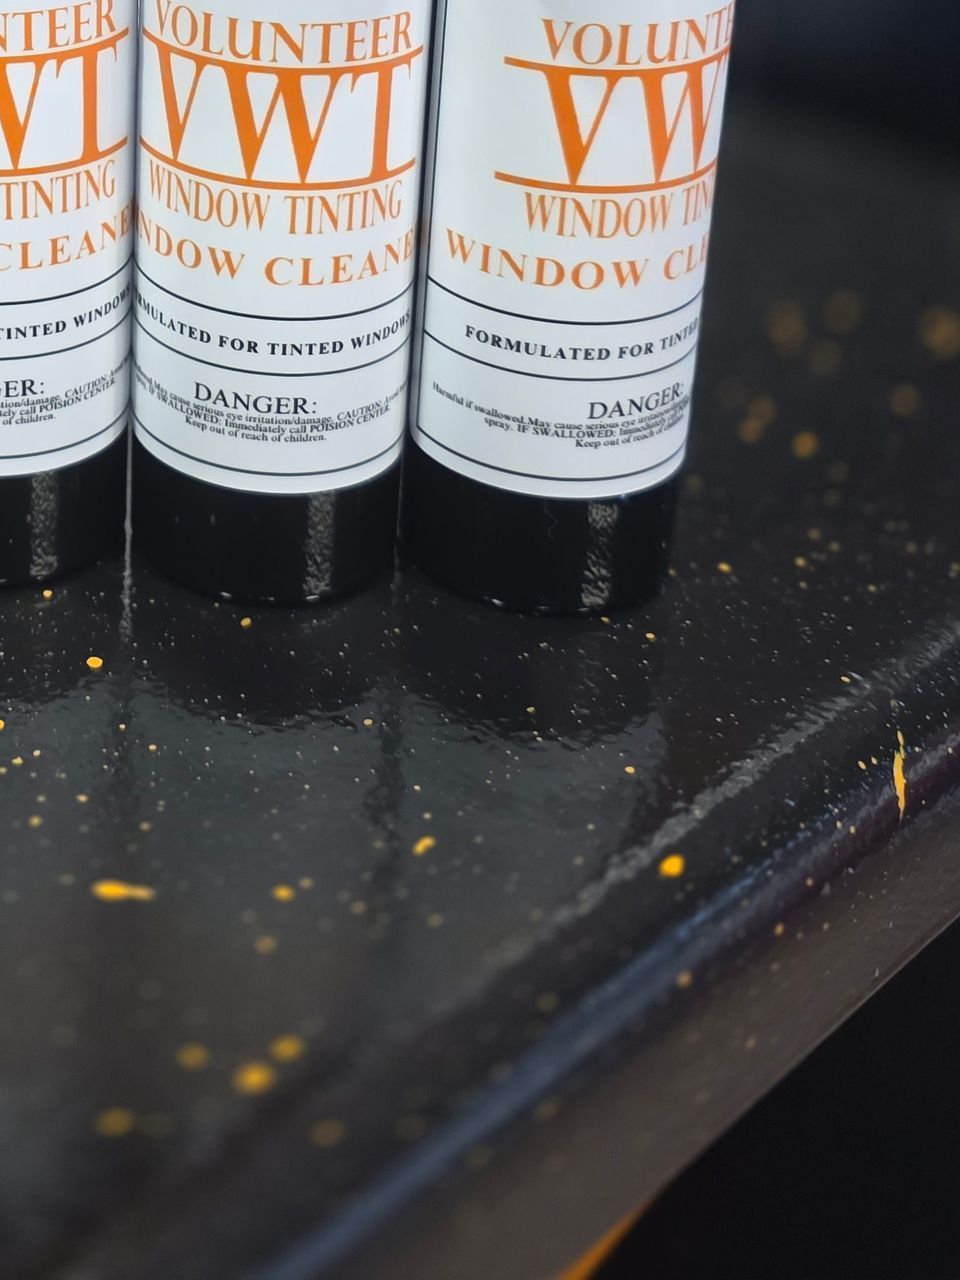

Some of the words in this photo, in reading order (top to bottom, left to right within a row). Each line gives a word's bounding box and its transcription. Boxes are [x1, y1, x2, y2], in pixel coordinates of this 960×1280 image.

[153, 42, 412, 185] VWT
[149, 159, 271, 232] WINDOW
[284, 179, 402, 235] TINTING
[524, 192, 674, 239] WINDOW
[446, 227, 650, 290] WINDOW
[218, 335, 259, 354] FOR
[267, 340, 343, 356] TINTED
[350, 308, 410, 350] WINDOWS
[465, 324, 611, 361] FORMULATED
[617, 342, 654, 359] FOR
[19, 406, 36, 416] call
[193, 403, 225, 417] serious
[226, 412, 243, 421] eye
[336, 399, 382, 421] CAUTION:
[194, 382, 317, 416] DANGER:
[432, 381, 464, 406] Harmful
[465, 400, 474, 409] if
[554, 422, 583, 431] cause
[587, 382, 684, 420] DANGER:
[2, 415, 15, 426] of
[185, 415, 208, 432] Keep
[209, 425, 225, 435] out
[228, 428, 240, 438] of
[241, 431, 268, 442] reach
[271, 433, 282, 443] of
[283, 433, 327, 443] children.
[225, 418, 286, 435] Immediately
[289, 425, 307, 434] call
[310, 420, 354, 433] POISION
[484, 416, 514, 431] spray.
[517, 424, 530, 433] IF
[532, 426, 616, 439] SWALLOWED:
[575, 439, 602, 449] Keep
[603, 437, 620, 446] out
